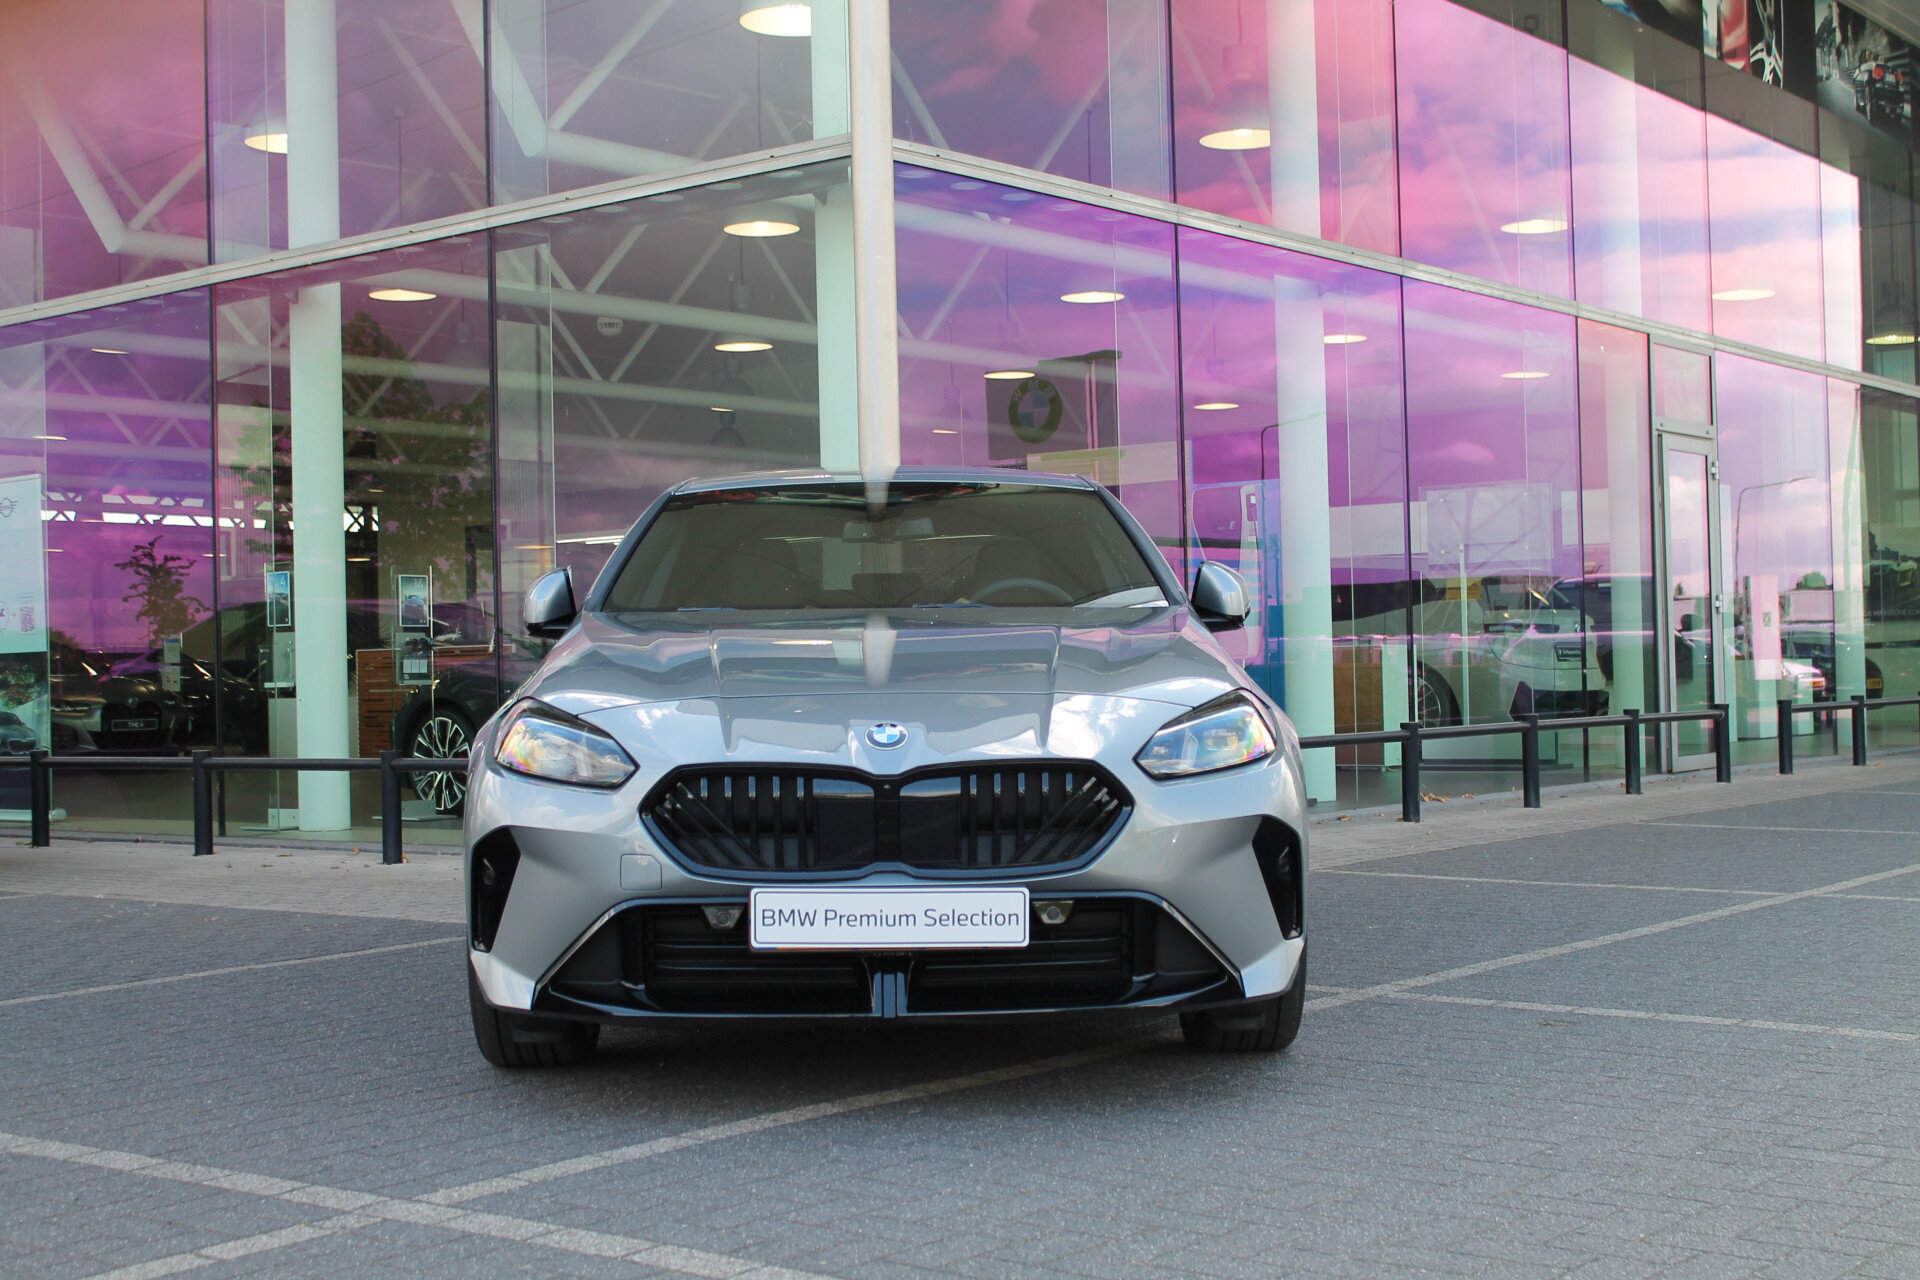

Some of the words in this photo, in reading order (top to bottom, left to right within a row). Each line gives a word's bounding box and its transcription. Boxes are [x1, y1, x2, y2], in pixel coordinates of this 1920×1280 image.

[761, 908, 818, 927] BMW
[824, 908, 917, 928] Premium
[923, 908, 1020, 927] Selection
